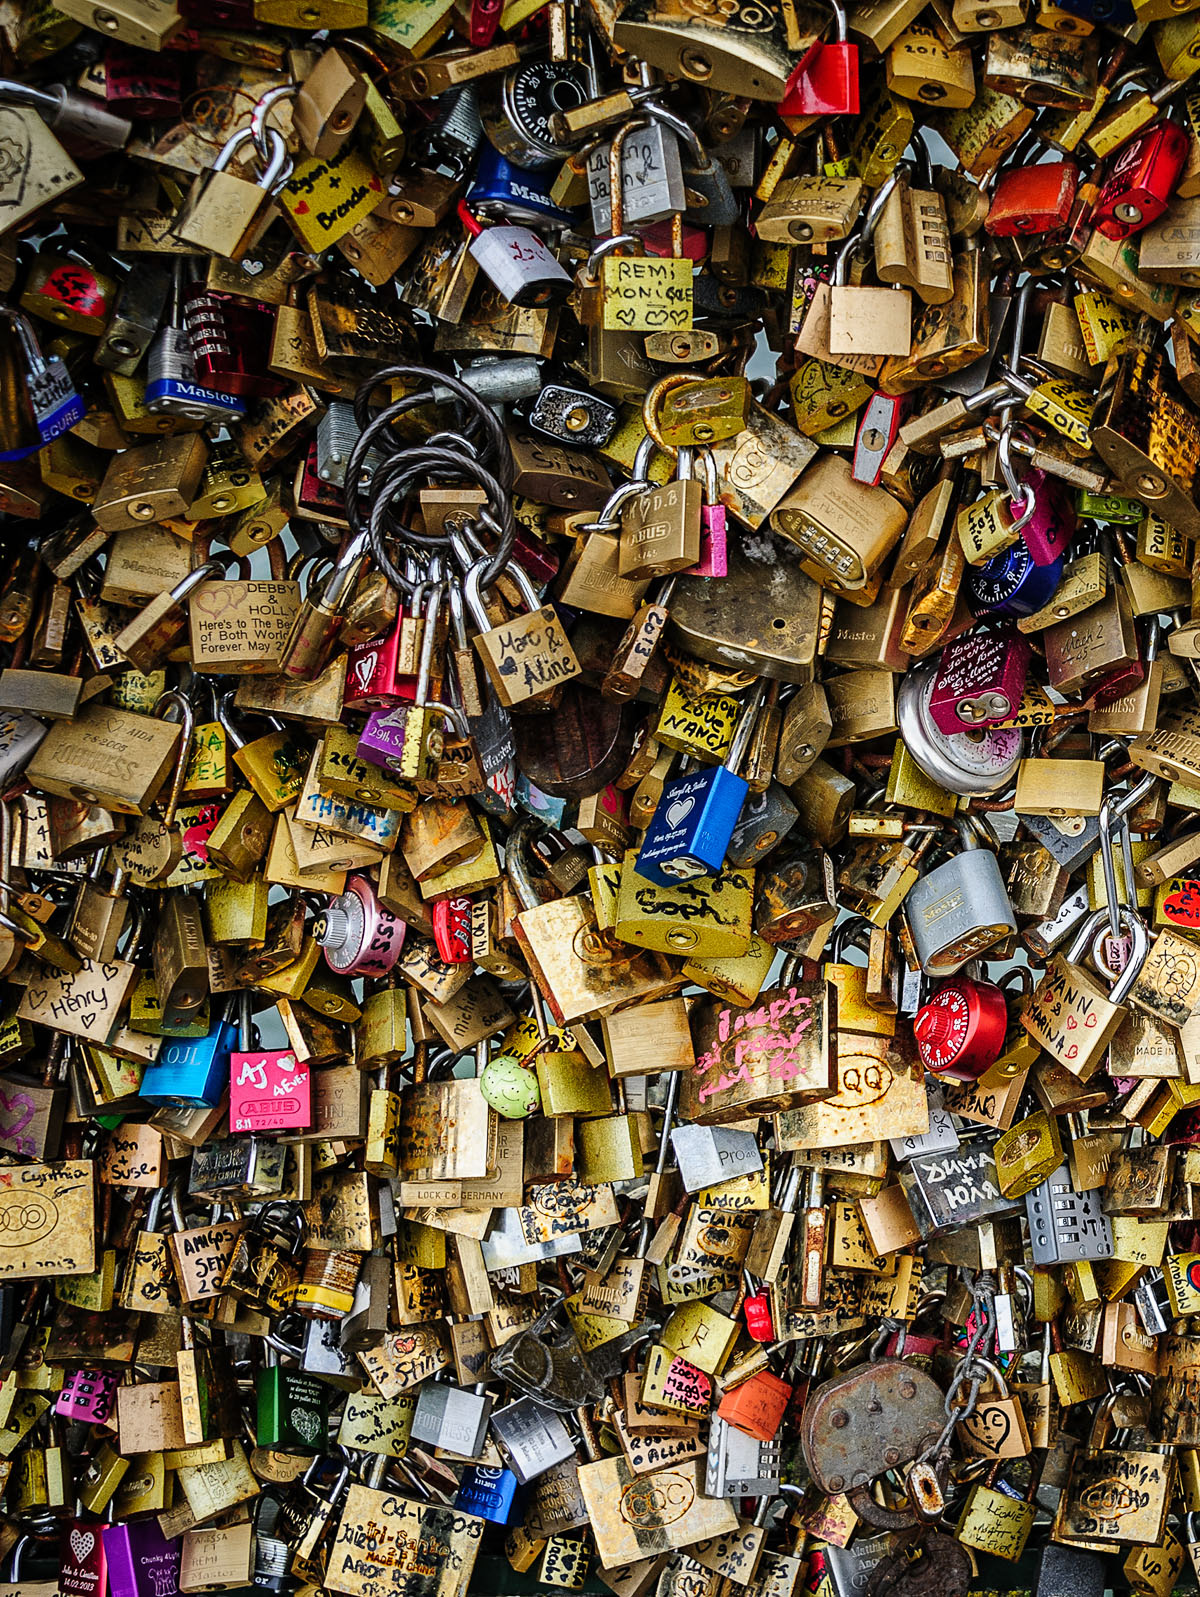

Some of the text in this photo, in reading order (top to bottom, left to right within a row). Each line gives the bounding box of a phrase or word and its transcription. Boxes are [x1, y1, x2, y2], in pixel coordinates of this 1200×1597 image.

[904, 43, 950, 60] 2013
[527, 76, 541, 90] 20
[545, 68, 557, 80] 25
[526, 96, 536, 109] 15
[287, 162, 329, 196] Ryan
[315, 184, 370, 232] Brenda
[176, 382, 238, 405] Master
[42, 407, 80, 442] ECURE
[1036, 400, 1089, 444] 2013
[628, 523, 666, 544] ABUS
[247, 582, 296, 595] DEBBY
[268, 595, 279, 605] &
[249, 605, 298, 617] HOLLY
[198, 618, 271, 631] Here's to The
[837, 628, 876, 641] Master
[200, 629, 291, 643] of Both World
[498, 626, 563, 659] Marc &
[248, 641, 271, 654] May
[523, 655, 576, 695] Aline
[125, 725, 155, 743] AIDA
[664, 714, 730, 752] NANCY
[50, 742, 141, 782] FORTRESS
[307, 793, 392, 838] THOMAS
[49, 986, 109, 1020] Henry
[1046, 970, 1093, 1016] YANN
[1136, 1046, 1162, 1056] MADE
[236, 1059, 268, 1091] AJ
[244, 1100, 295, 1115] ABUS
[254, 1118, 285, 1127] 72/40
[20, 1169, 90, 1188] Cynthia
[920, 1152, 996, 1184] ДИМА
[960, 1173, 975, 1187] +
[417, 1190, 504, 1201] LOCK GERMANY
[703, 1193, 756, 1208] Andrea
[942, 1180, 1000, 1210] ЮЛЯ
[183, 1228, 235, 1256] AMIGOS
[1168, 1255, 1191, 1311] Margaux
[666, 1376, 711, 1400] Maggie
[416, 1415, 473, 1444] FORTRESS
